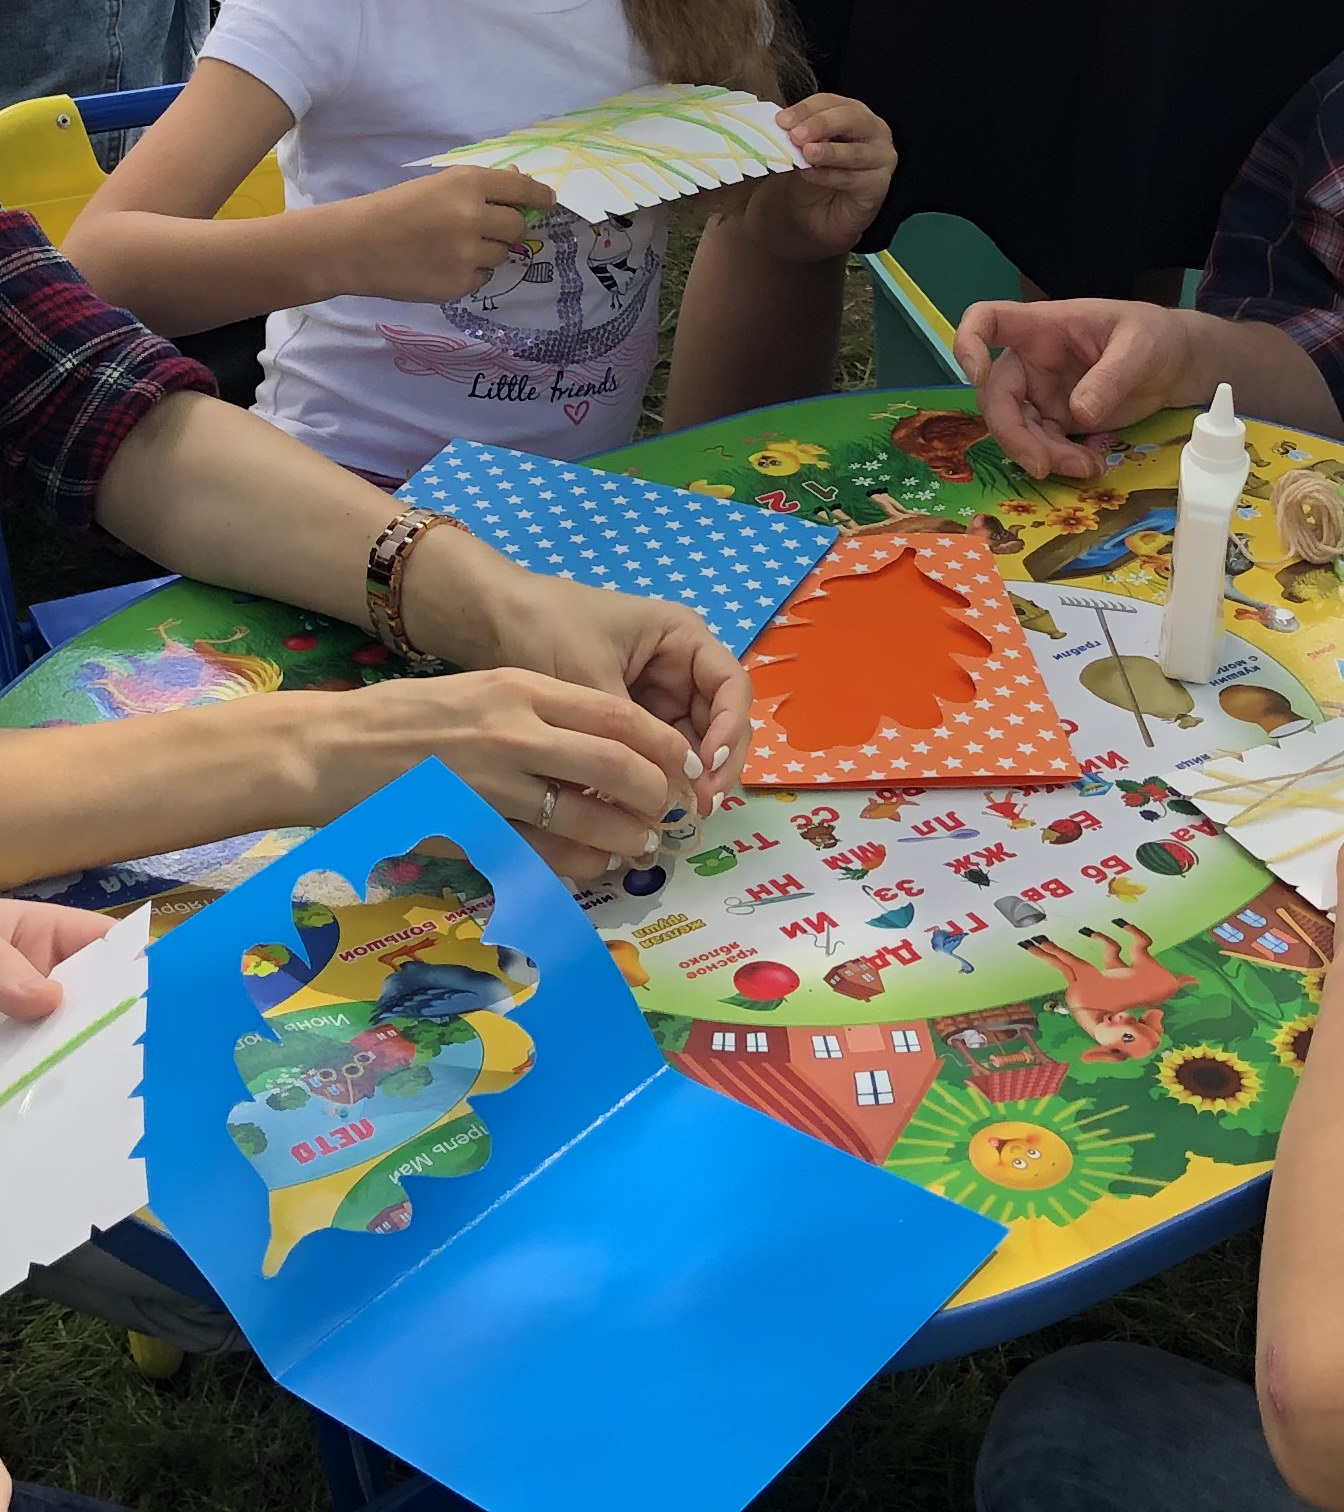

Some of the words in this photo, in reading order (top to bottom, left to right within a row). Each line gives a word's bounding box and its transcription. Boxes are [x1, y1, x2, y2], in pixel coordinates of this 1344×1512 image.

[468, 372, 539, 402] Little
[550, 367, 618, 403] friends
[756, 490, 801, 514] 2
[1052, 640, 1102, 661] грабли
[1209, 665, 1261, 687] кувшин
[1175, 753, 1211, 770] яйца
[911, 811, 966, 836] Лл
[1170, 818, 1221, 842] Аа
[733, 832, 780, 854] Тт
[822, 841, 885, 870] Мм
[943, 842, 1017, 874] Жж
[1080, 854, 1133, 884] Бб
[745, 873, 806, 902] Нн
[873, 879, 925, 902] Зз
[1020, 877, 1074, 902] Вв
[632, 913, 688, 938] груша
[779, 911, 840, 940] Ии
[679, 941, 741, 969] яблоко
[686, 948, 758, 979] красное
[859, 938, 923, 971] Дд
[284, 1013, 350, 1033] Июнь
[290, 1119, 375, 1164] ЛЕТО
[388, 1154, 434, 1185] Май
